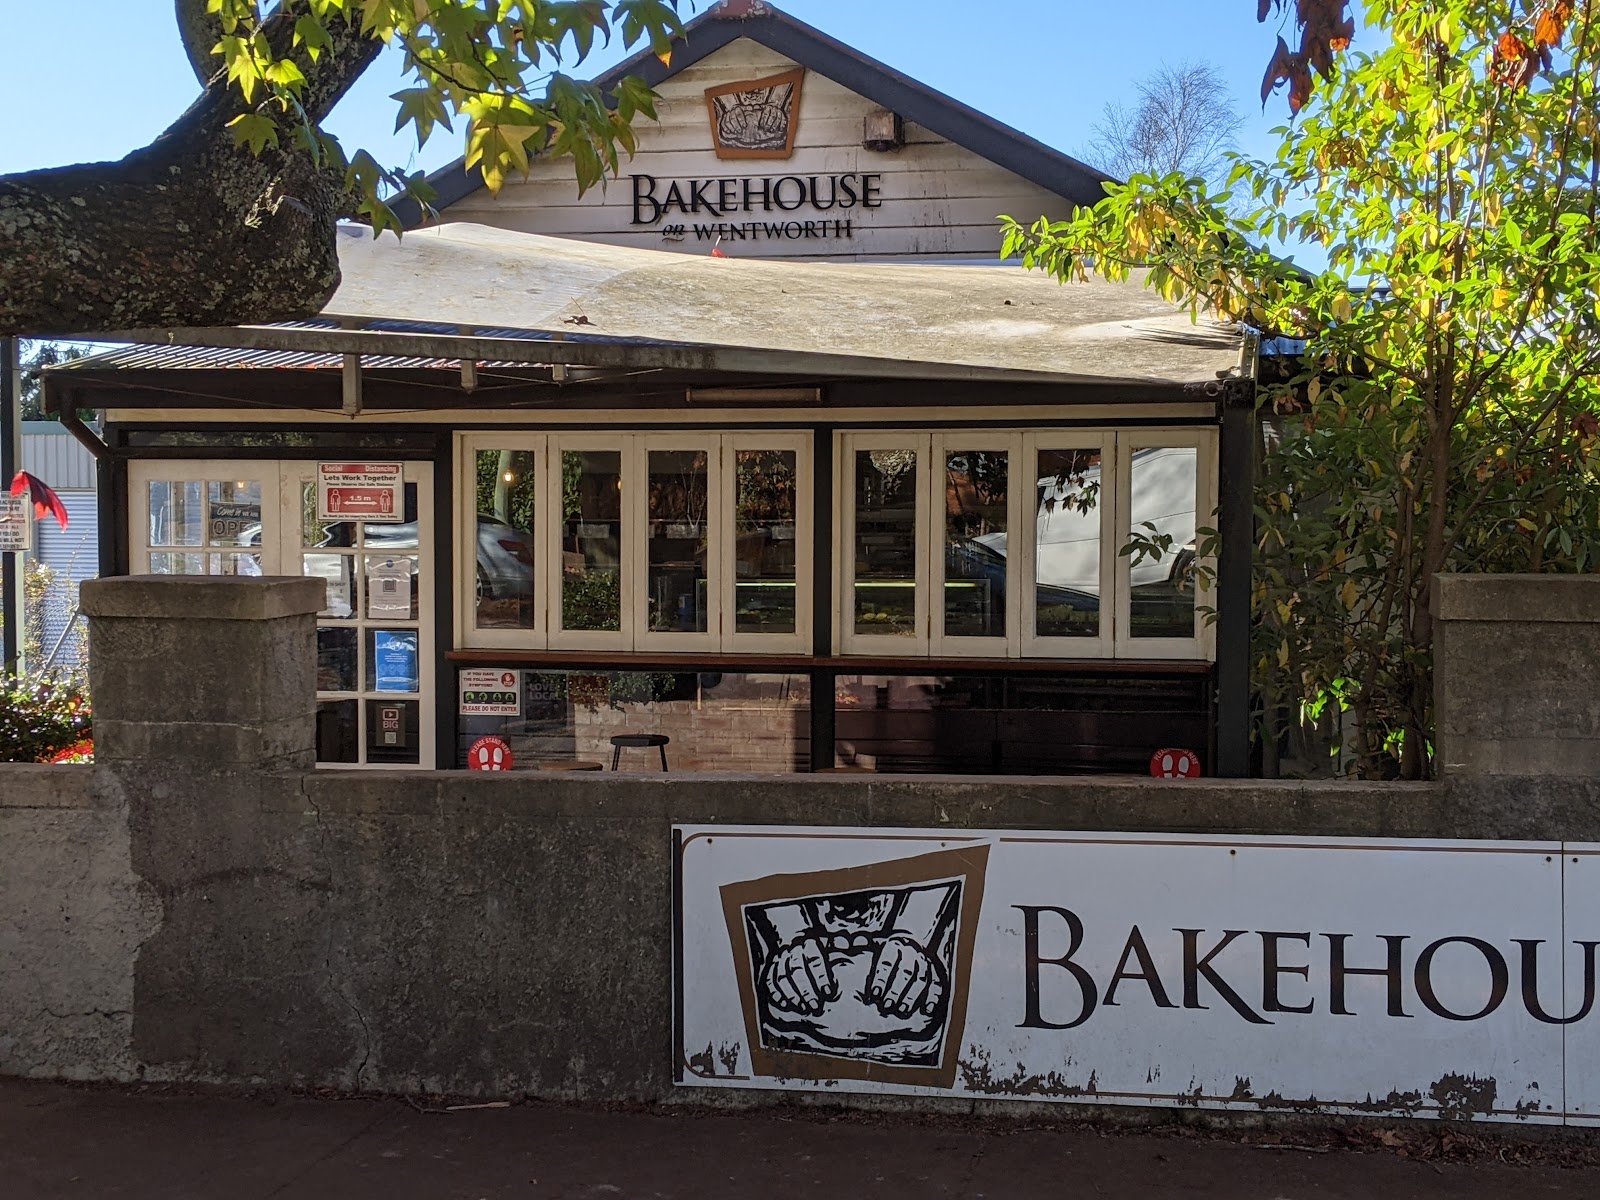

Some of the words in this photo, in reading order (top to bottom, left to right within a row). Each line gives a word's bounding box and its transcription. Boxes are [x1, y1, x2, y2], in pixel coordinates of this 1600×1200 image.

[629, 174, 882, 225] BAKEHOUSE
[662, 222, 684, 237] on
[693, 219, 852, 241] WENTWORTH
[342, 474, 361, 482] Work
[363, 474, 397, 482] Together
[365, 465, 397, 474] Distancing
[217, 506, 235, 516] Come
[471, 739, 486, 754] PLEASE
[485, 737, 501, 745] STAND
[1010, 904, 1600, 1030] BAKEHOU
